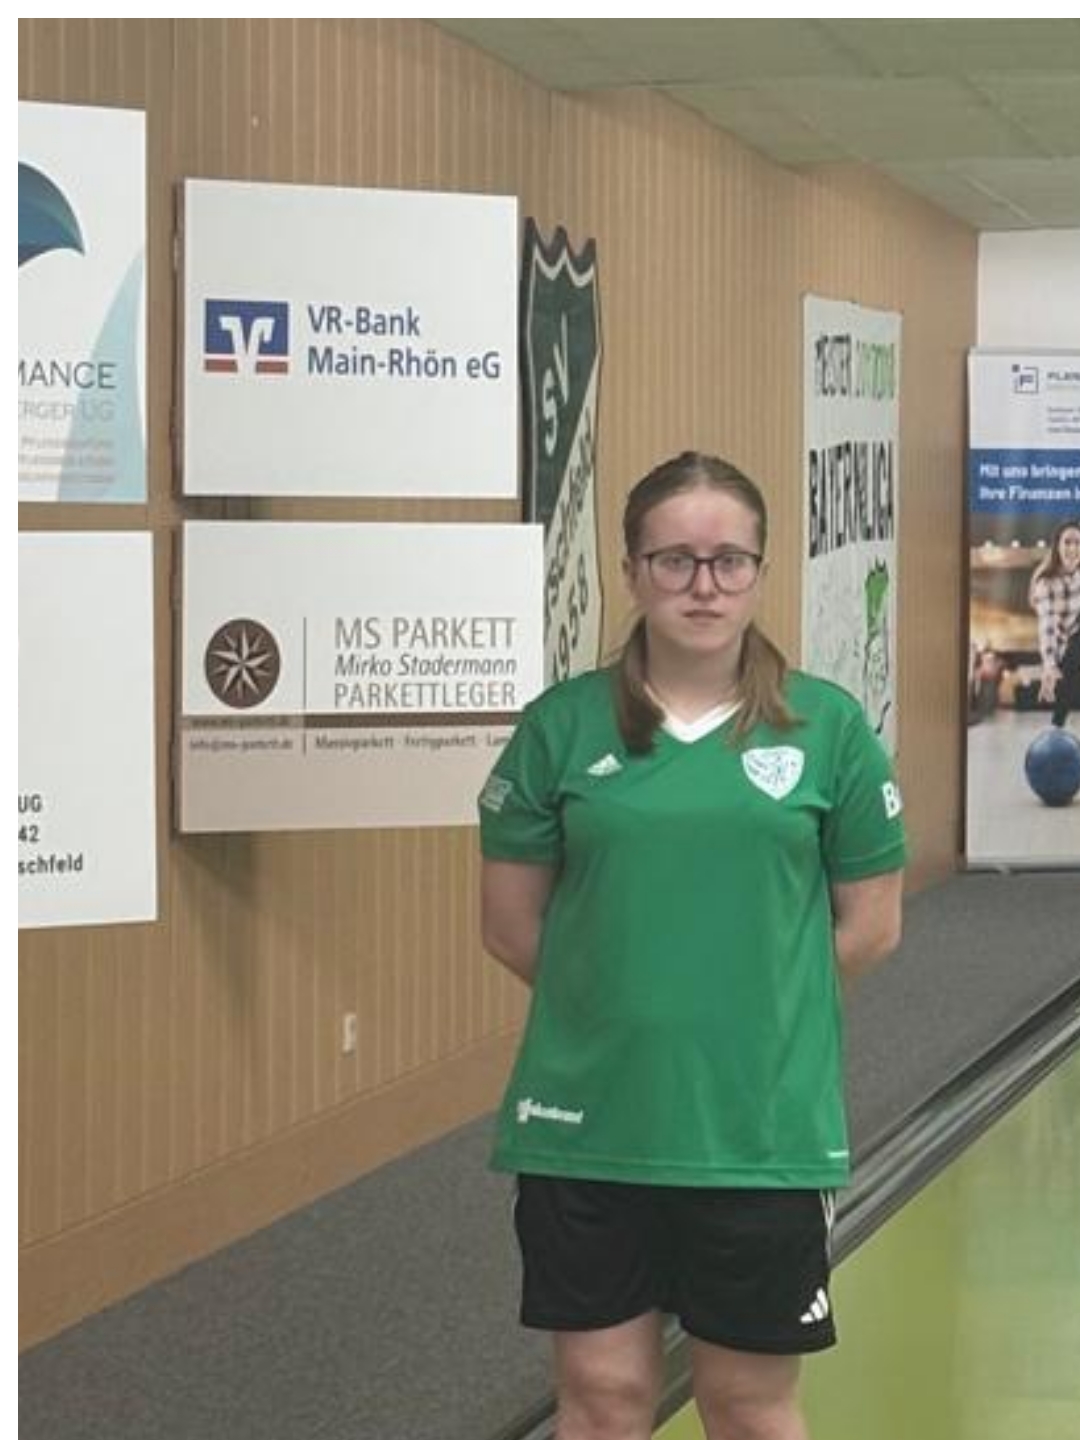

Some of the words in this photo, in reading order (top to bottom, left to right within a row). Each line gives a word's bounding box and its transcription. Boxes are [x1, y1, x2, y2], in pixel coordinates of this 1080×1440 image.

[308, 305, 421, 338] VR-Bank
[308, 346, 457, 379] Main-Rhön
[465, 350, 501, 380] eG
[1003, 466, 1028, 479] uns
[1008, 485, 1072, 501] Finanzen
[335, 616, 381, 649] MS
[392, 616, 517, 649] PARKETT
[335, 654, 392, 677] Mirko
[399, 653, 518, 677] Stadermann
[335, 681, 516, 708] PARKETTLEGER
